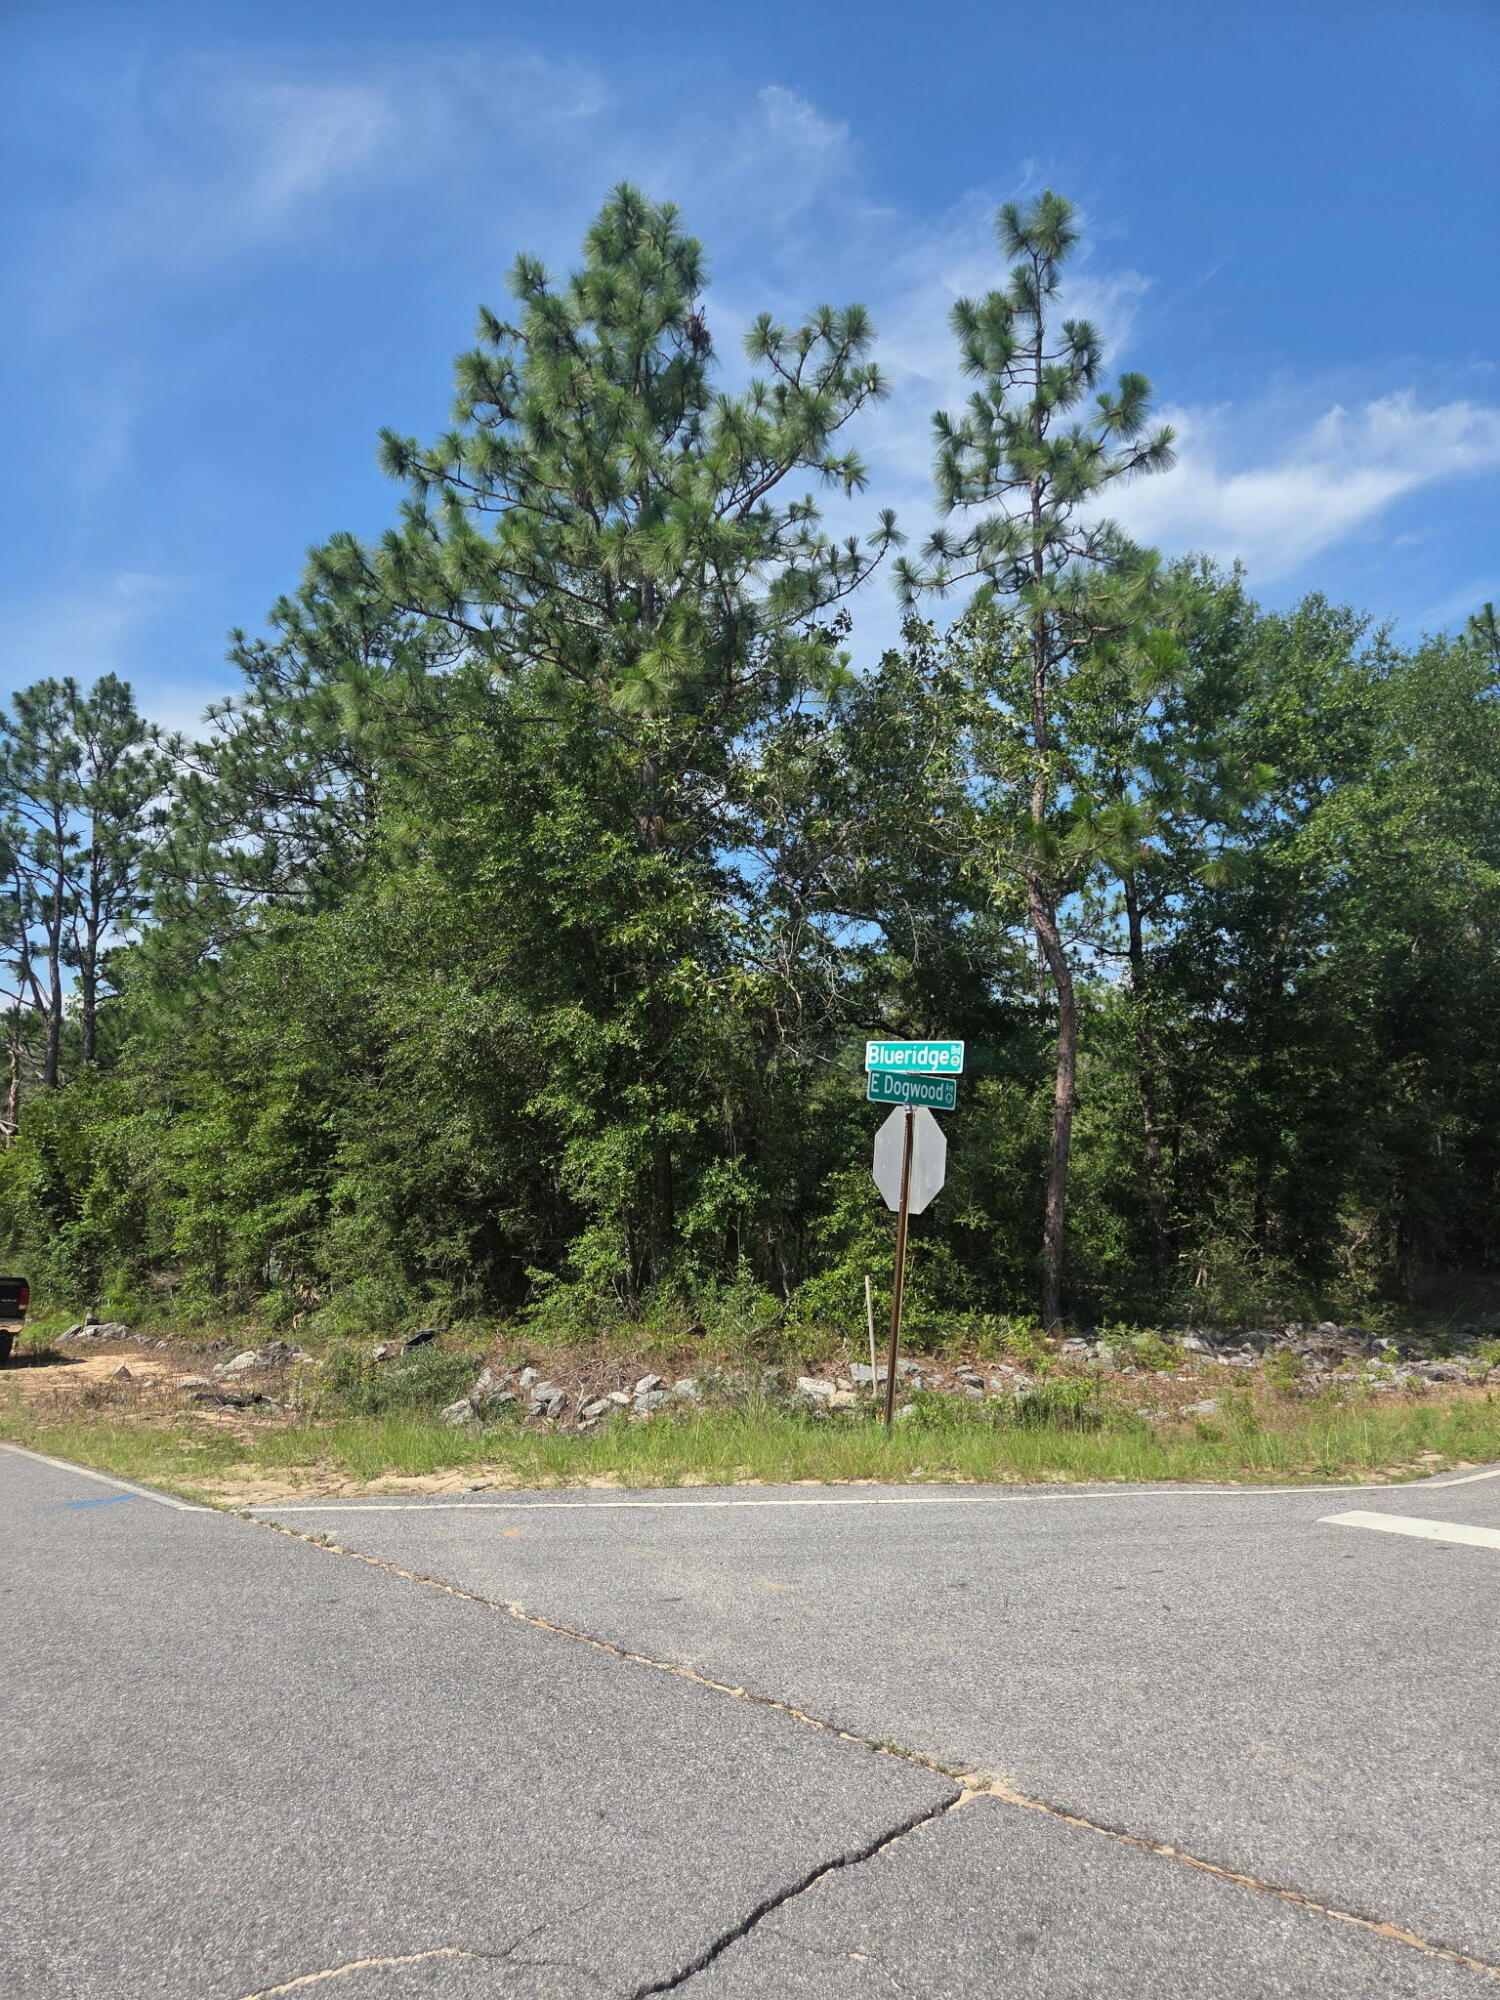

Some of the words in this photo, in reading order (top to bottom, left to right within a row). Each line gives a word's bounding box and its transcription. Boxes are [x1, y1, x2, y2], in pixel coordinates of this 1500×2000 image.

[868, 1045, 950, 1071] Blueridge
[871, 1073, 880, 1093] E
[884, 1075, 944, 1102] Dogwood
